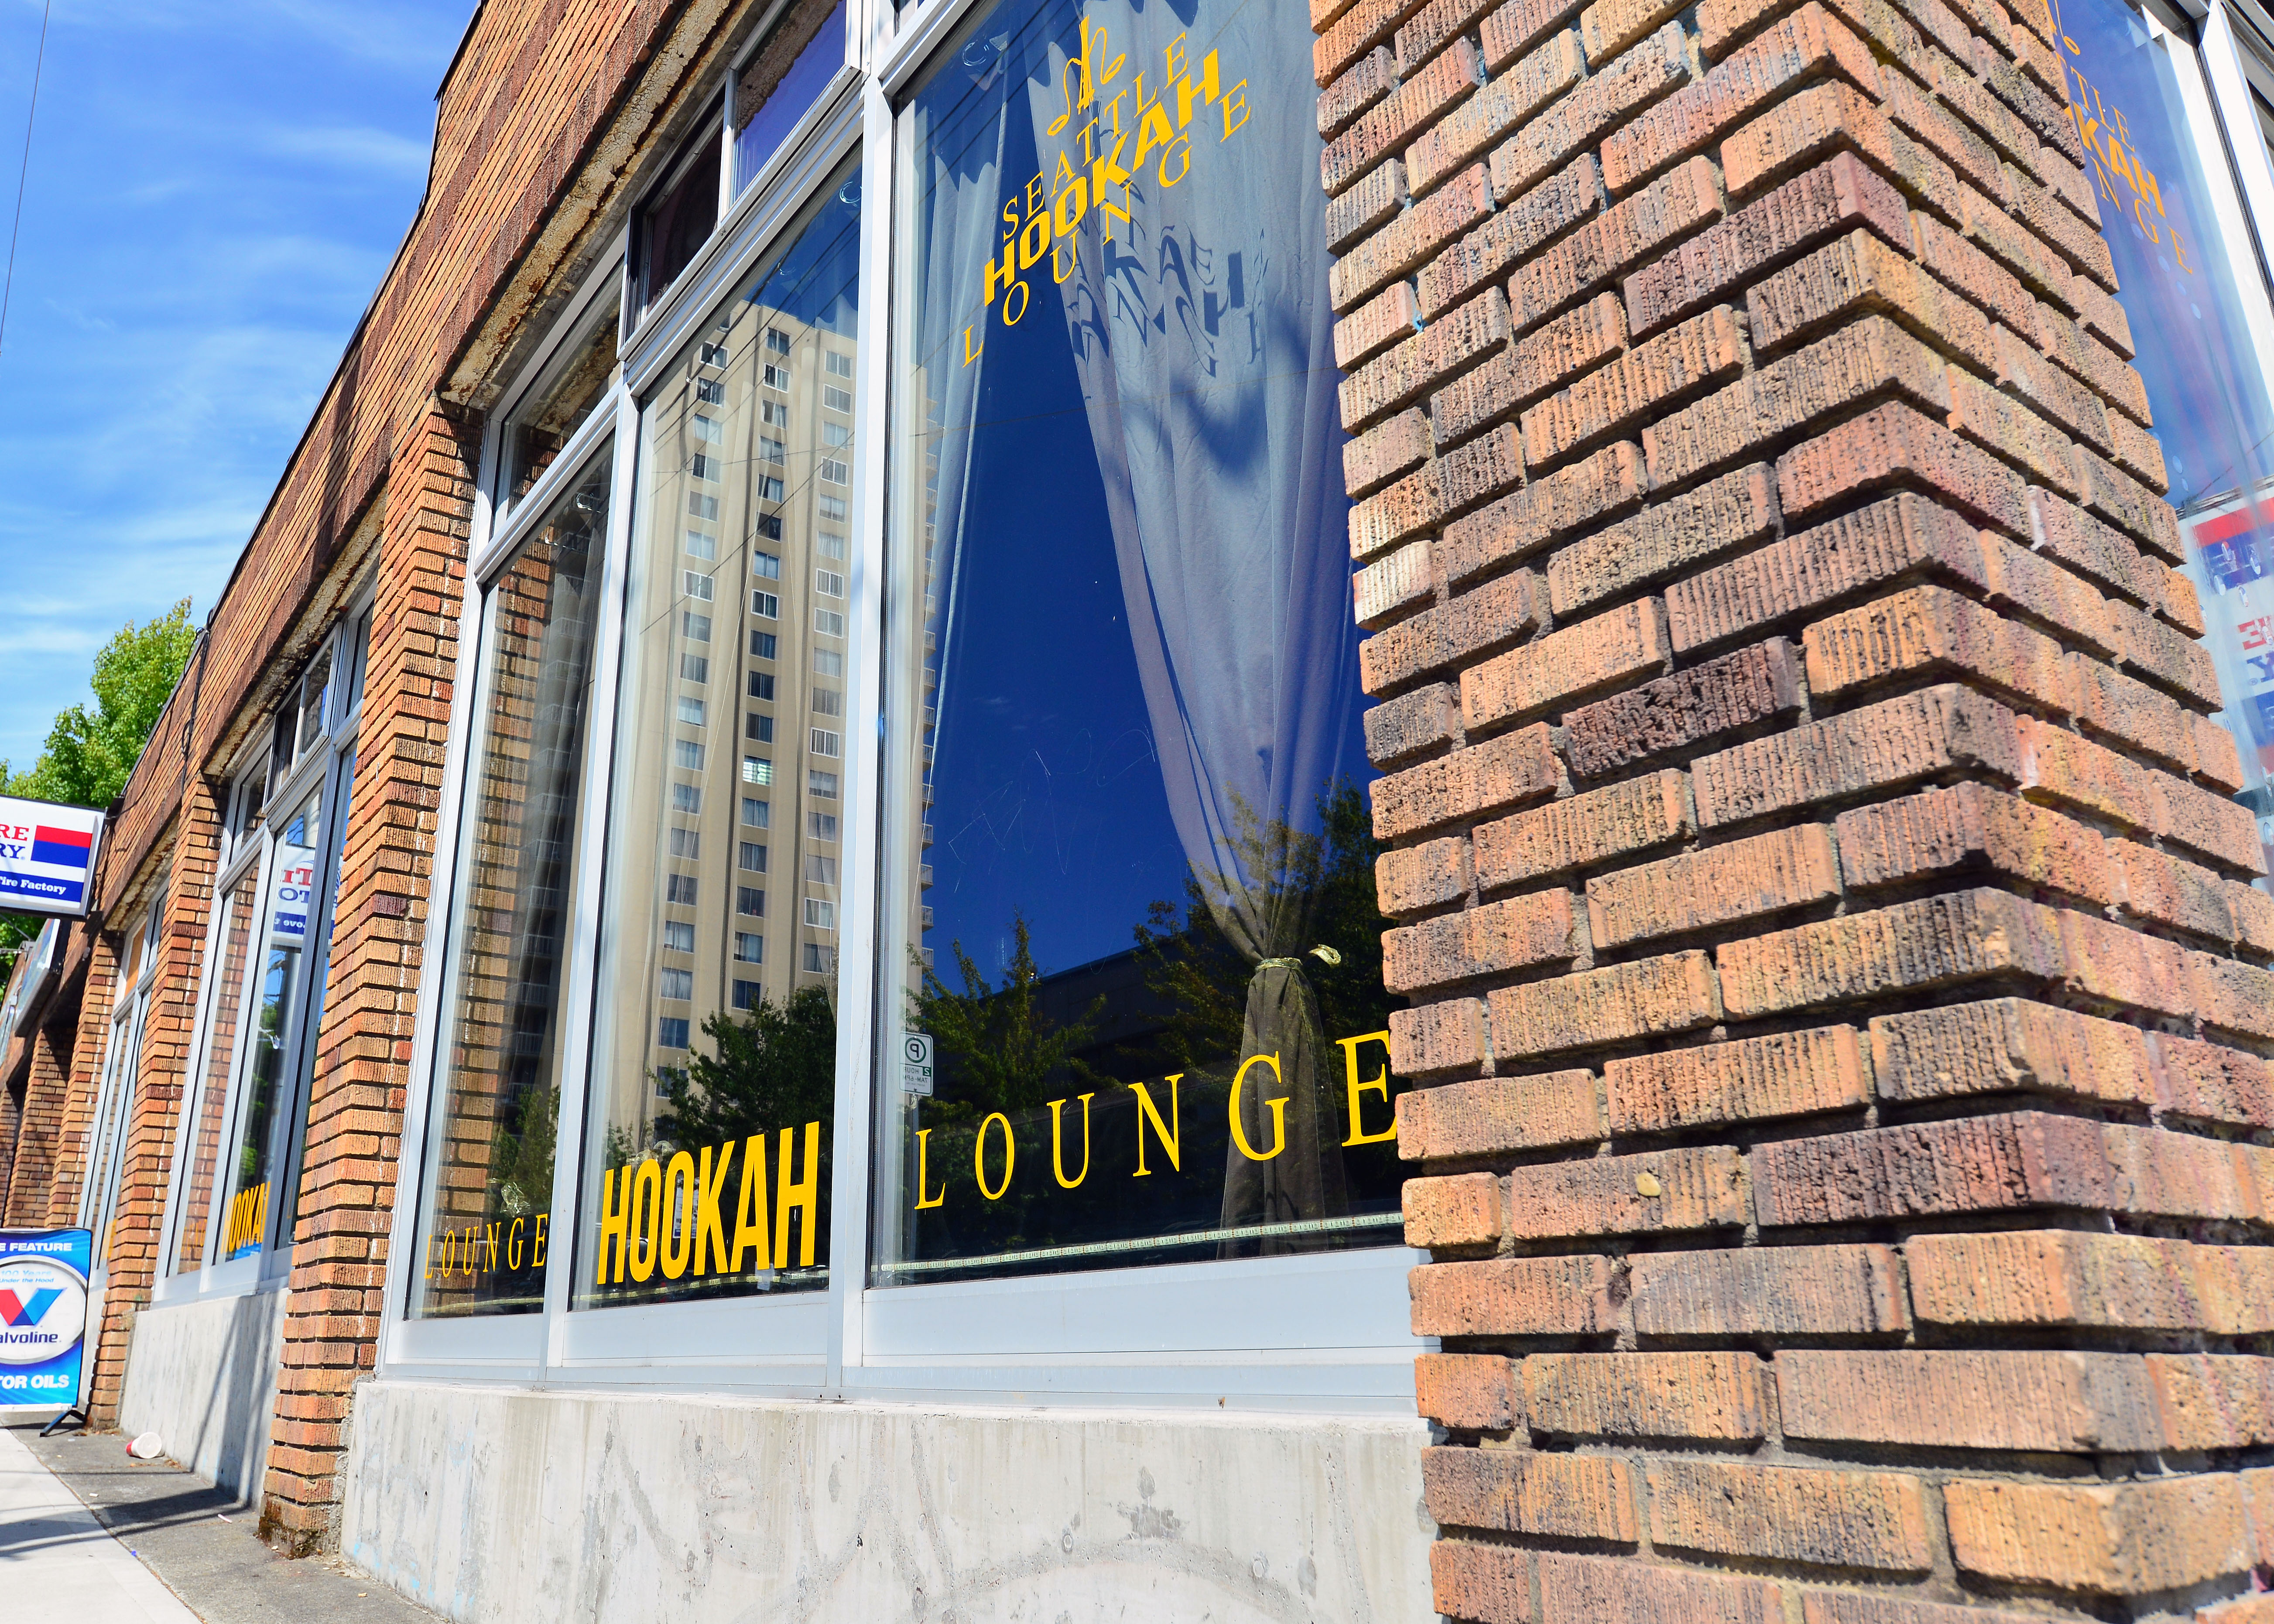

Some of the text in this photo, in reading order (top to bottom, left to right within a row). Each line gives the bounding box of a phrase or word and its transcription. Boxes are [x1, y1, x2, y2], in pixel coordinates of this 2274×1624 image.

[984, 48, 1220, 307] HOOKAH
[1003, 31, 1189, 241] SEATTLE
[962, 78, 1251, 368] LOUNGE
[21, 879, 66, 895] Factory
[914, 1029, 1397, 1210] LOUNGE
[10, 1243, 72, 1251] FEATURE
[424, 1214, 548, 1279] LOUNGE
[597, 1121, 819, 1285] HOOKAH
[0, 1374, 69, 1389] OR OILS
